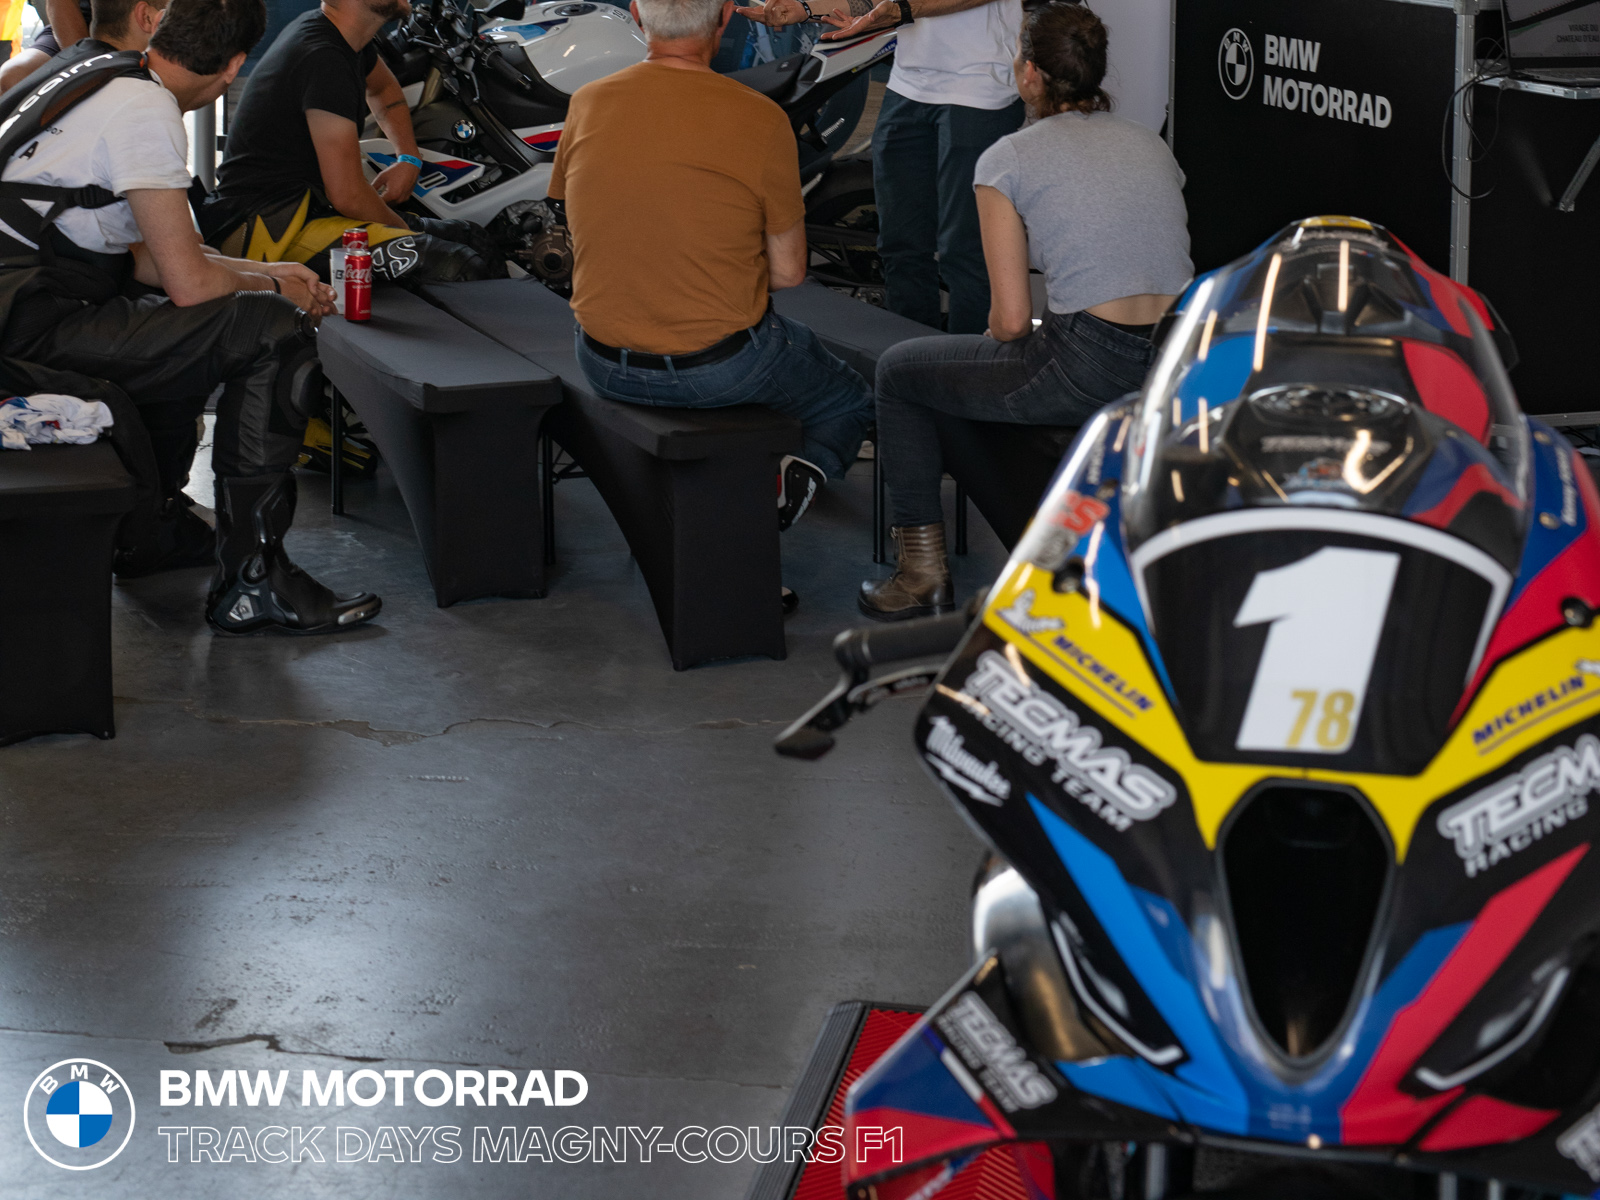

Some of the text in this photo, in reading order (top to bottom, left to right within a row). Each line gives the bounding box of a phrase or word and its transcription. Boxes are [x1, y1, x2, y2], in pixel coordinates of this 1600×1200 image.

[1264, 33, 1321, 73] BMW
[1262, 74, 1392, 129] MOTORRAD
[1052, 634, 1154, 711] MICHELIN
[1233, 545, 1402, 755] 1
[965, 649, 1177, 821] TECMAS
[1285, 689, 1356, 752] 78
[1472, 676, 1585, 746] MICHELIN
[956, 689, 1134, 833] CING TEAM
[1464, 797, 1589, 878] RACING
[949, 990, 1059, 1110] TECMAS
